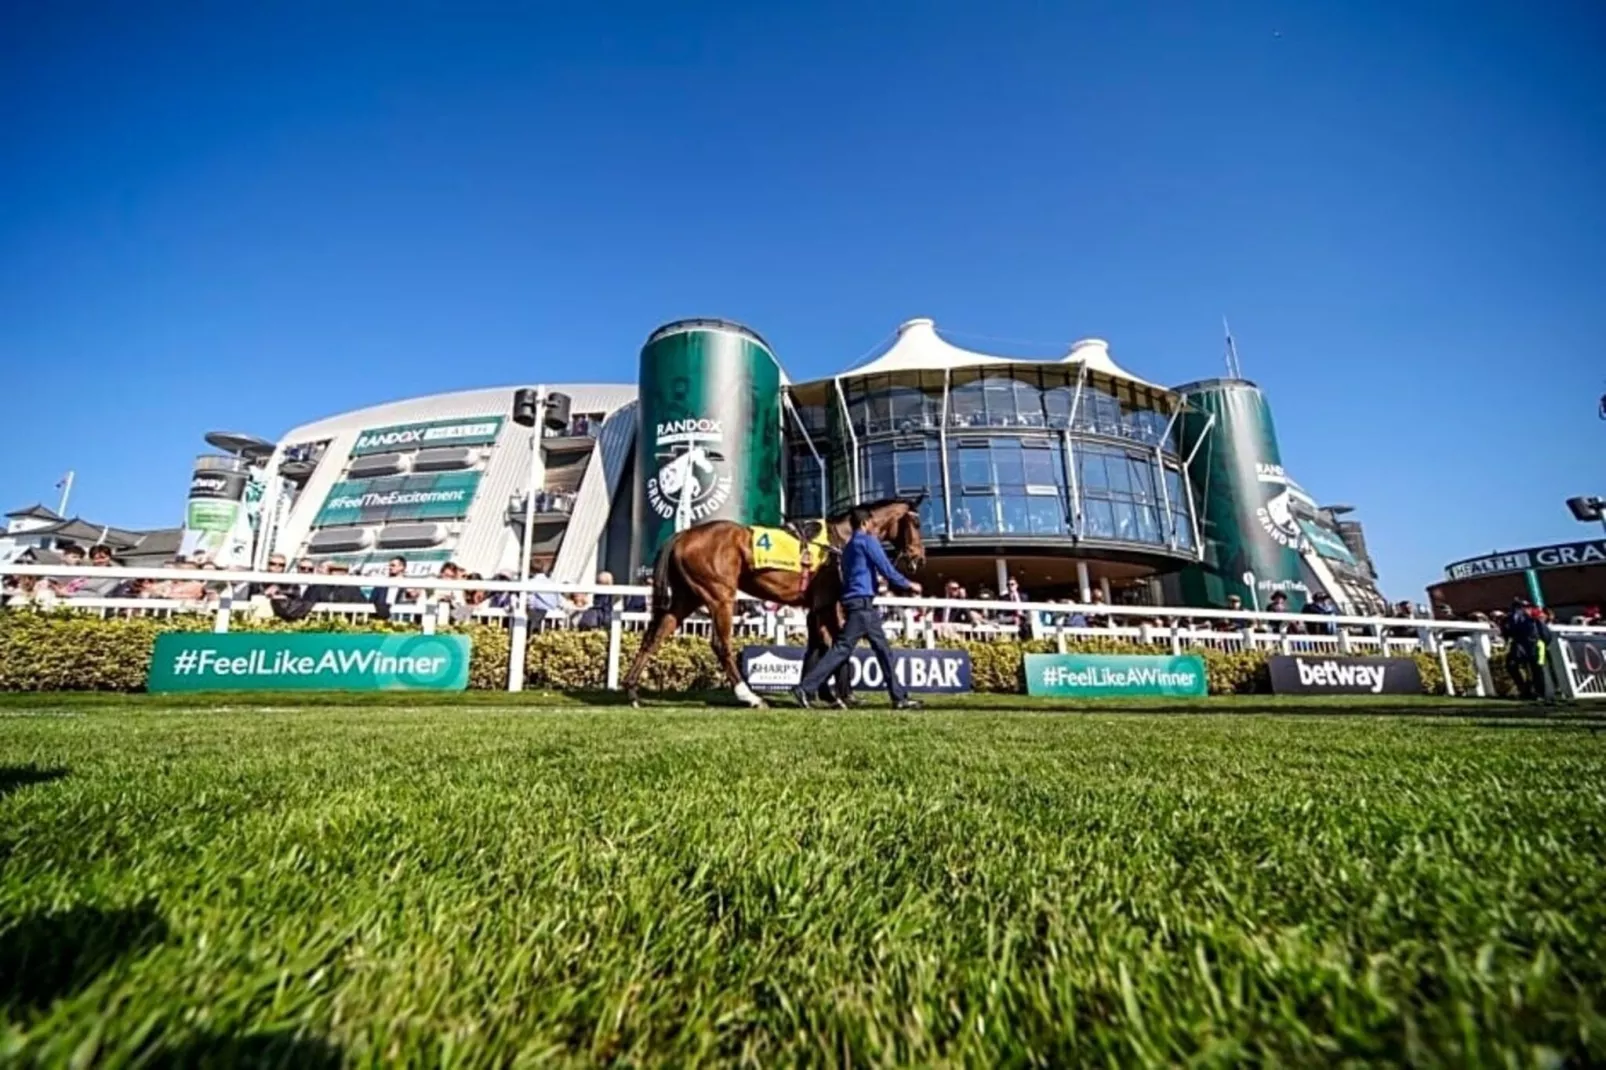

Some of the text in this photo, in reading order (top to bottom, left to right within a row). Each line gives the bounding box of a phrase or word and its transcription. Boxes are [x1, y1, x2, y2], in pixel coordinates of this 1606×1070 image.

[355, 427, 424, 448] RANDOX
[656, 418, 723, 437] RANDOX
[647, 477, 675, 520] GRAND
[756, 532, 771, 551] 4
[1454, 543, 1606, 577] HEALTH GRA
[173, 649, 446, 676] #FeelLikeAWinner
[911, 658, 962, 688] BAR
[1042, 665, 1197, 687] #FeelLikeAWinner
[1296, 657, 1385, 693] betway
